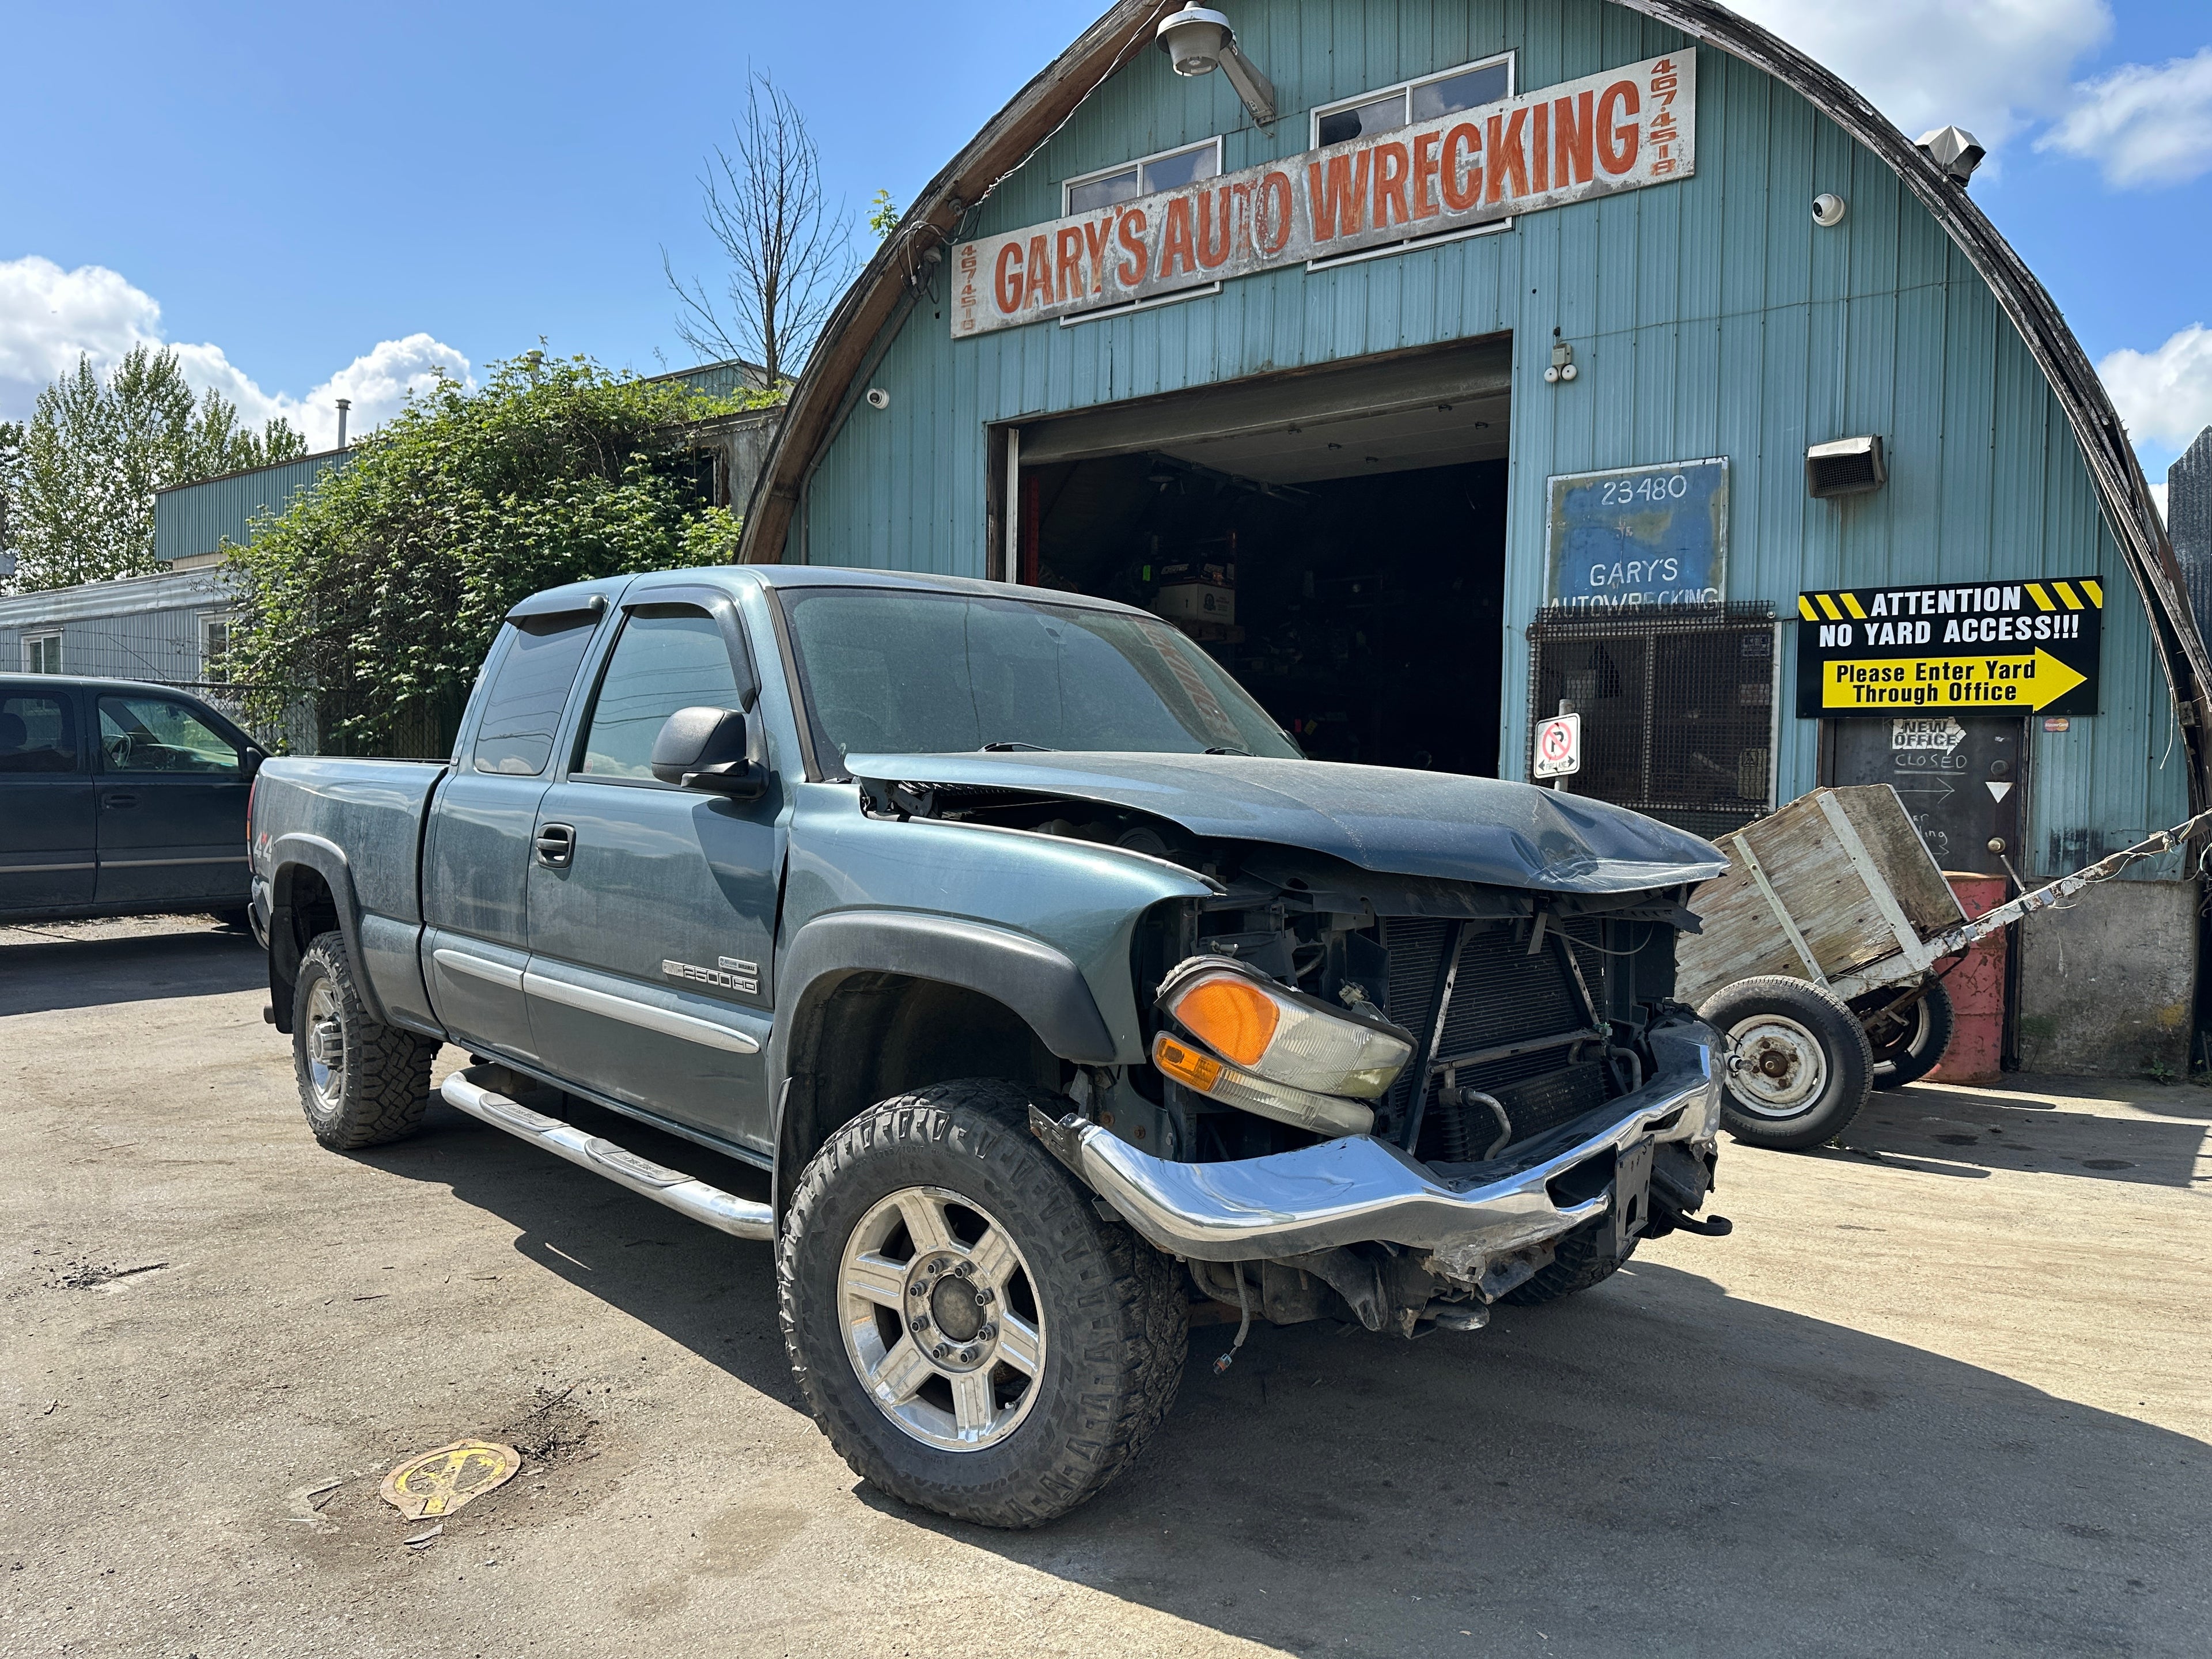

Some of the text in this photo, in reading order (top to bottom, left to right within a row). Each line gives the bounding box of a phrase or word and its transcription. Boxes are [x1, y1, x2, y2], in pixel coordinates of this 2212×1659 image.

[994, 79, 1641, 314] GARY'S AUTO WRECKING
[1601, 474, 1688, 506] 23480
[1589, 557, 1678, 588] GARY'S
[1870, 586, 2021, 618] ATTENTION
[1819, 614, 2079, 647] NO YARD ACCESS!!!
[1836, 659, 2036, 683] Please Enter Yard
[1853, 682, 2017, 706] Through Office
[1894, 733, 1957, 746] OFFICE
[1903, 721, 1947, 733] NEW
[1895, 753, 1967, 769] CLOSED
